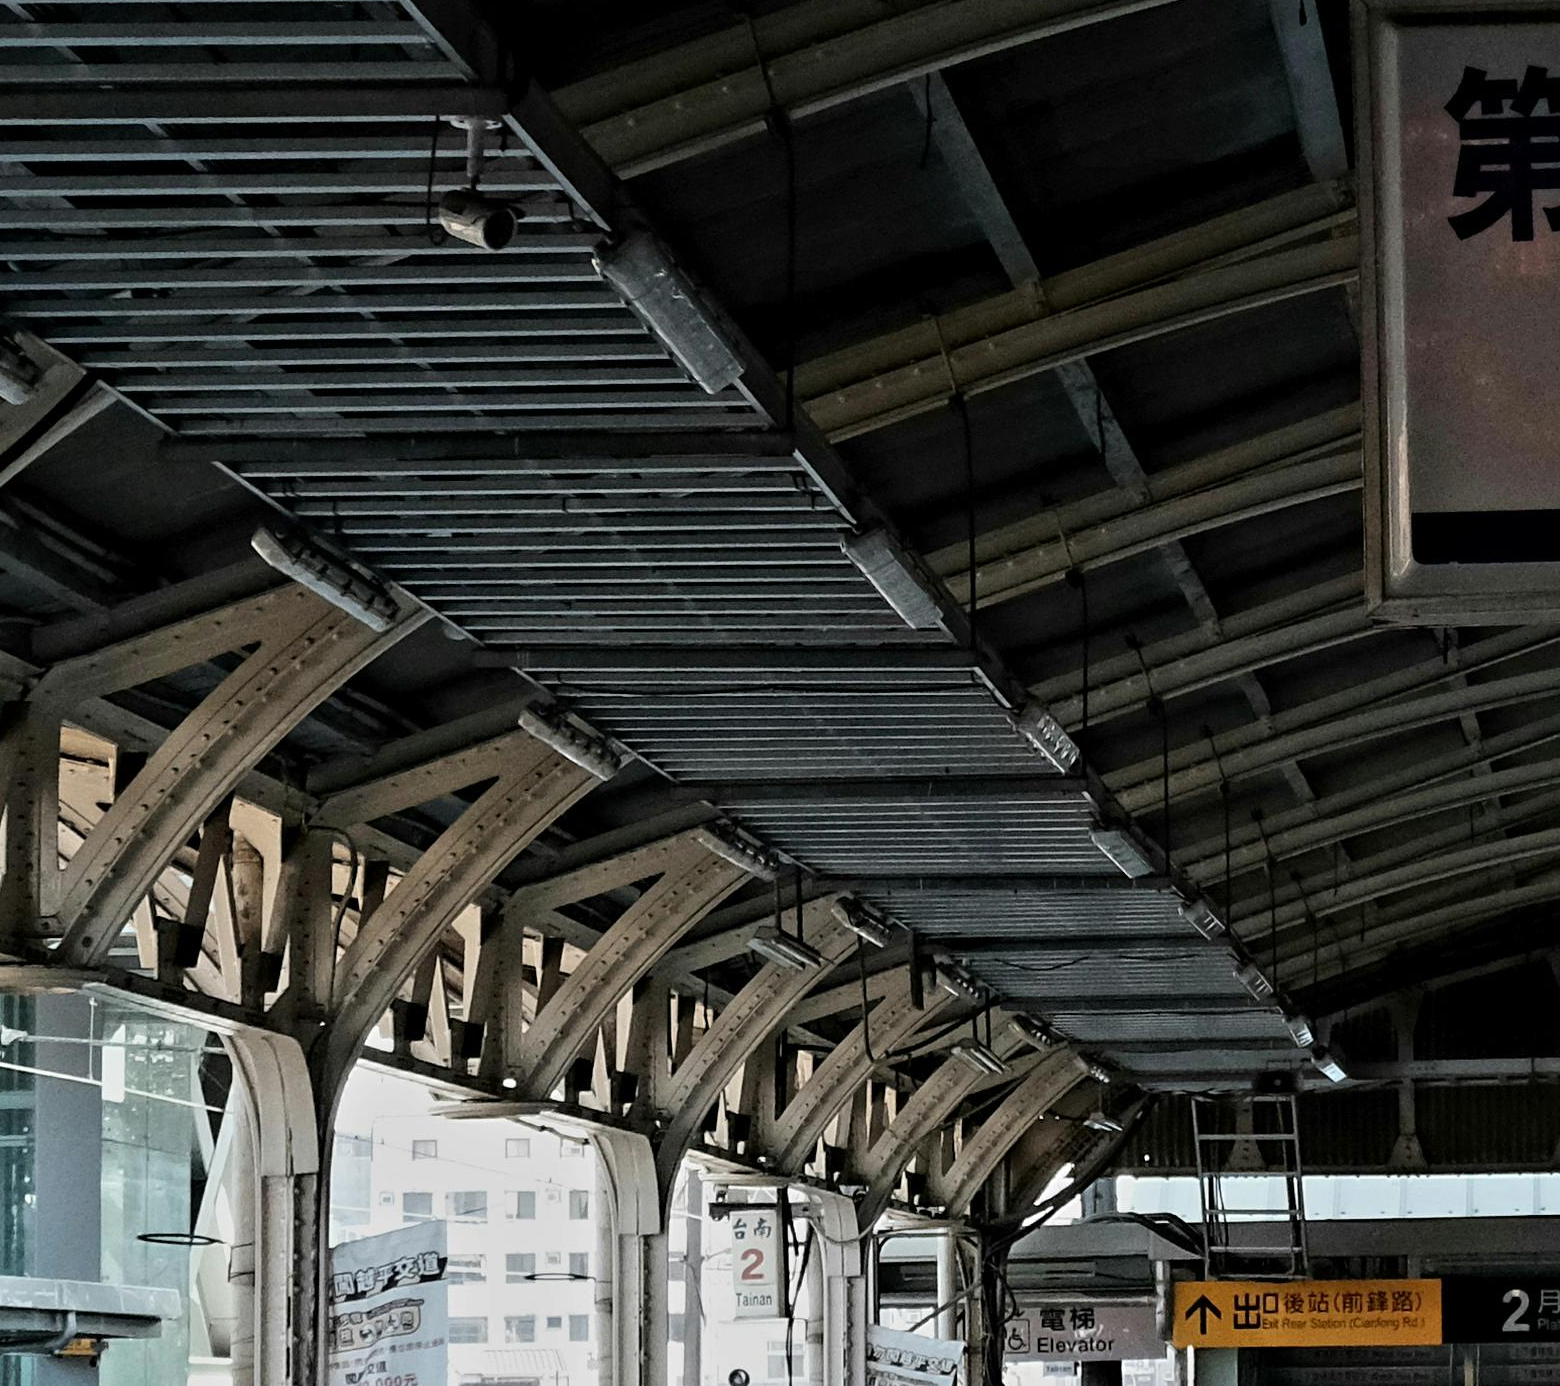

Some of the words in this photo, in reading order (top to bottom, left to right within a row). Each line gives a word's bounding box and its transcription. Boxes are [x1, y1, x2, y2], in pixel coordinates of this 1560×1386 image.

[733, 1217, 771, 1240] 台南
[741, 1248, 765, 1281] 2
[736, 1293, 772, 1307] Tainan
[1502, 1288, 1530, 1332] 2
[1040, 1308, 1096, 1331] 電梯
[1037, 1337, 1115, 1353] Elevator
